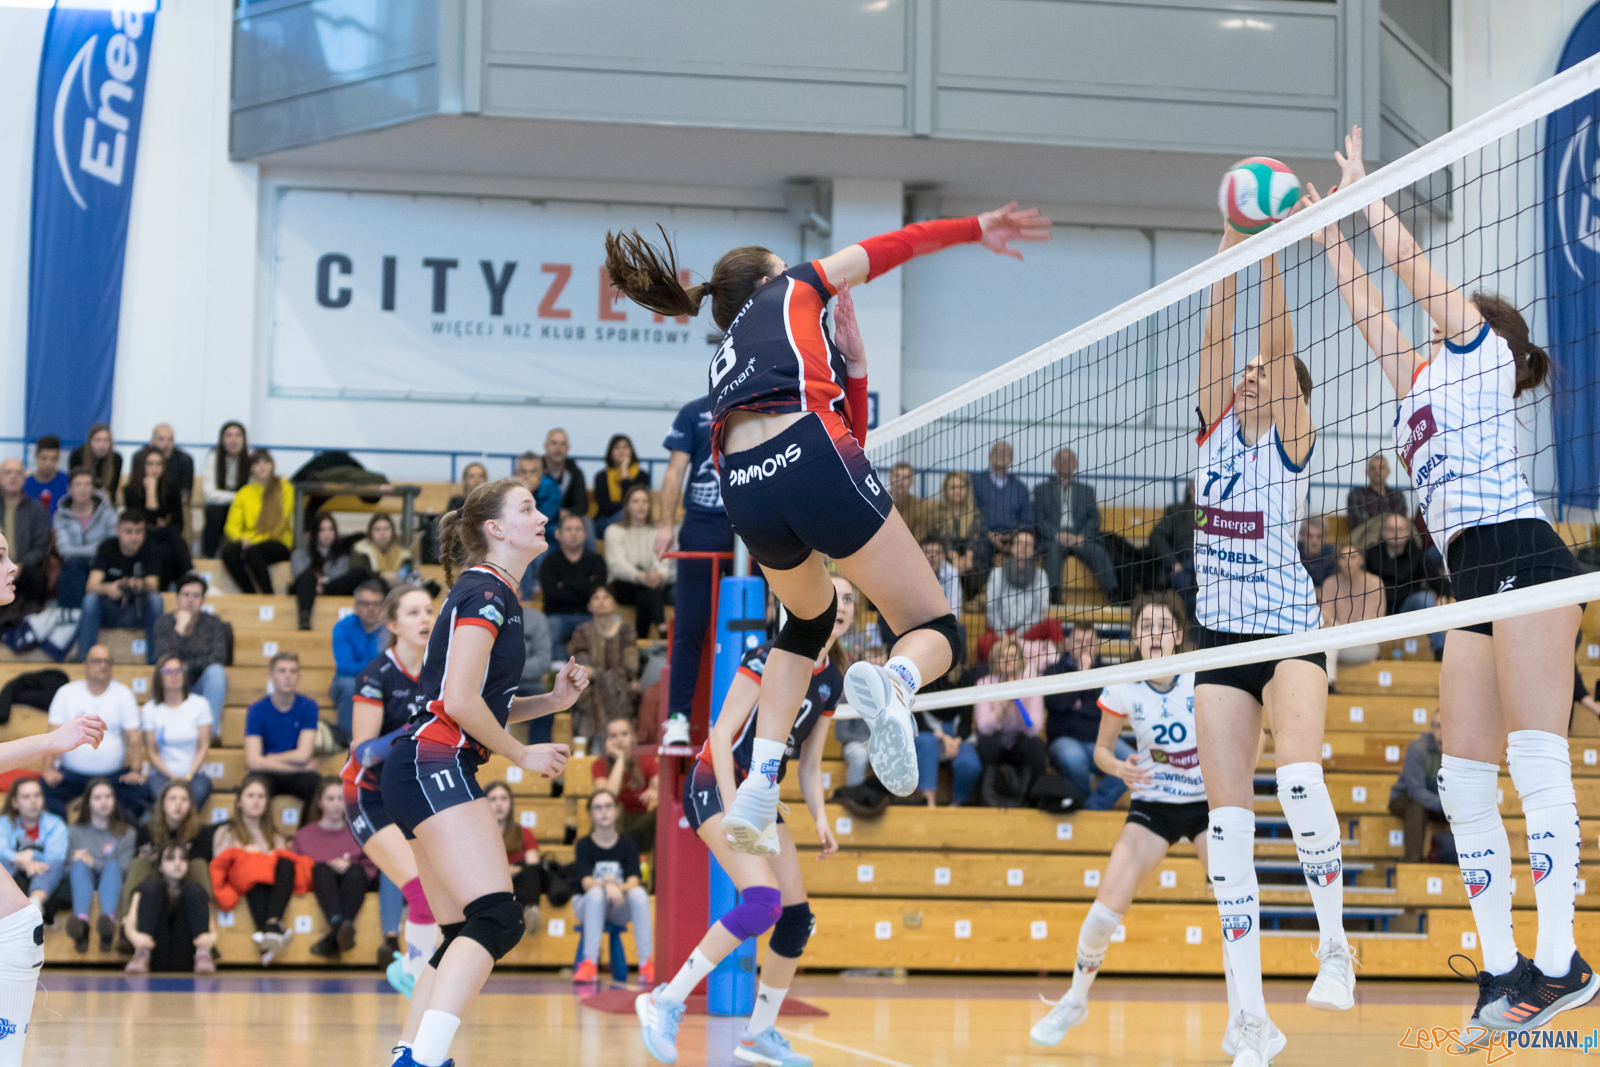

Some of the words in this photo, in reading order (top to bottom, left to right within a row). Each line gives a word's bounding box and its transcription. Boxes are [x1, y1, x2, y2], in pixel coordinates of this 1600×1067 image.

[80, 0, 146, 186] Enea
[541, 326, 586, 341] KLUB
[596, 326, 690, 345] SPORTOWY
[864, 473, 881, 497] 8
[1202, 470, 1242, 500] 77
[1213, 514, 1257, 535] Energa
[1152, 722, 1187, 745] 20
[427, 769, 455, 792] 11
[698, 790, 708, 806] 7
